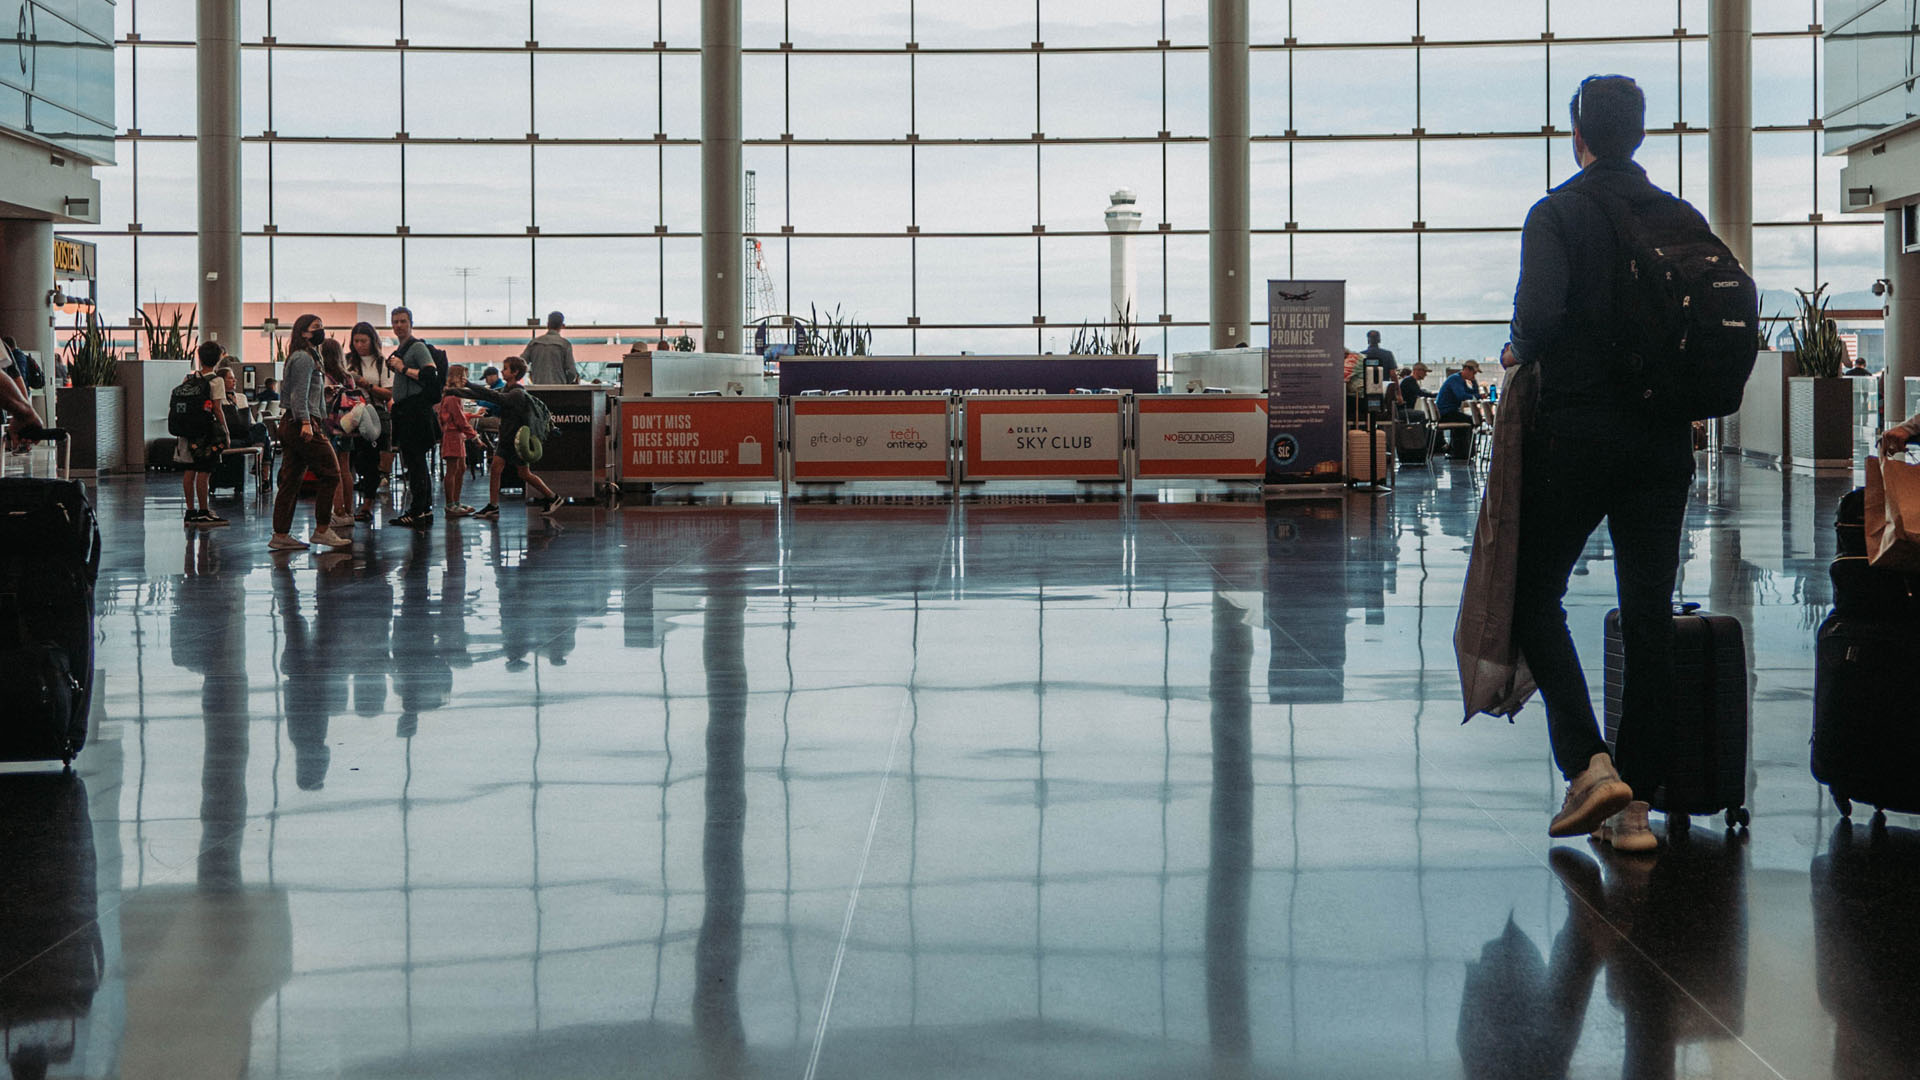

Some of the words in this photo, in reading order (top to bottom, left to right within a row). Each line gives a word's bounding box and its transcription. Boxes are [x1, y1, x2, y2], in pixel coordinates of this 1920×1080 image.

[1272, 313, 1287, 328] FLY
[1290, 313, 1330, 328] HEALTHY
[1272, 330, 1315, 345] PROMISE
[632, 414, 662, 429] DON'T
[665, 414, 691, 429] MISS
[632, 432, 663, 447] THESE
[666, 432, 699, 447] SHOPS
[1017, 436, 1047, 449] SKY
[632, 450, 653, 464] AND
[656, 450, 674, 464] THE
[677, 450, 696, 464] SKY
[1278, 446, 1290, 457] SLC
